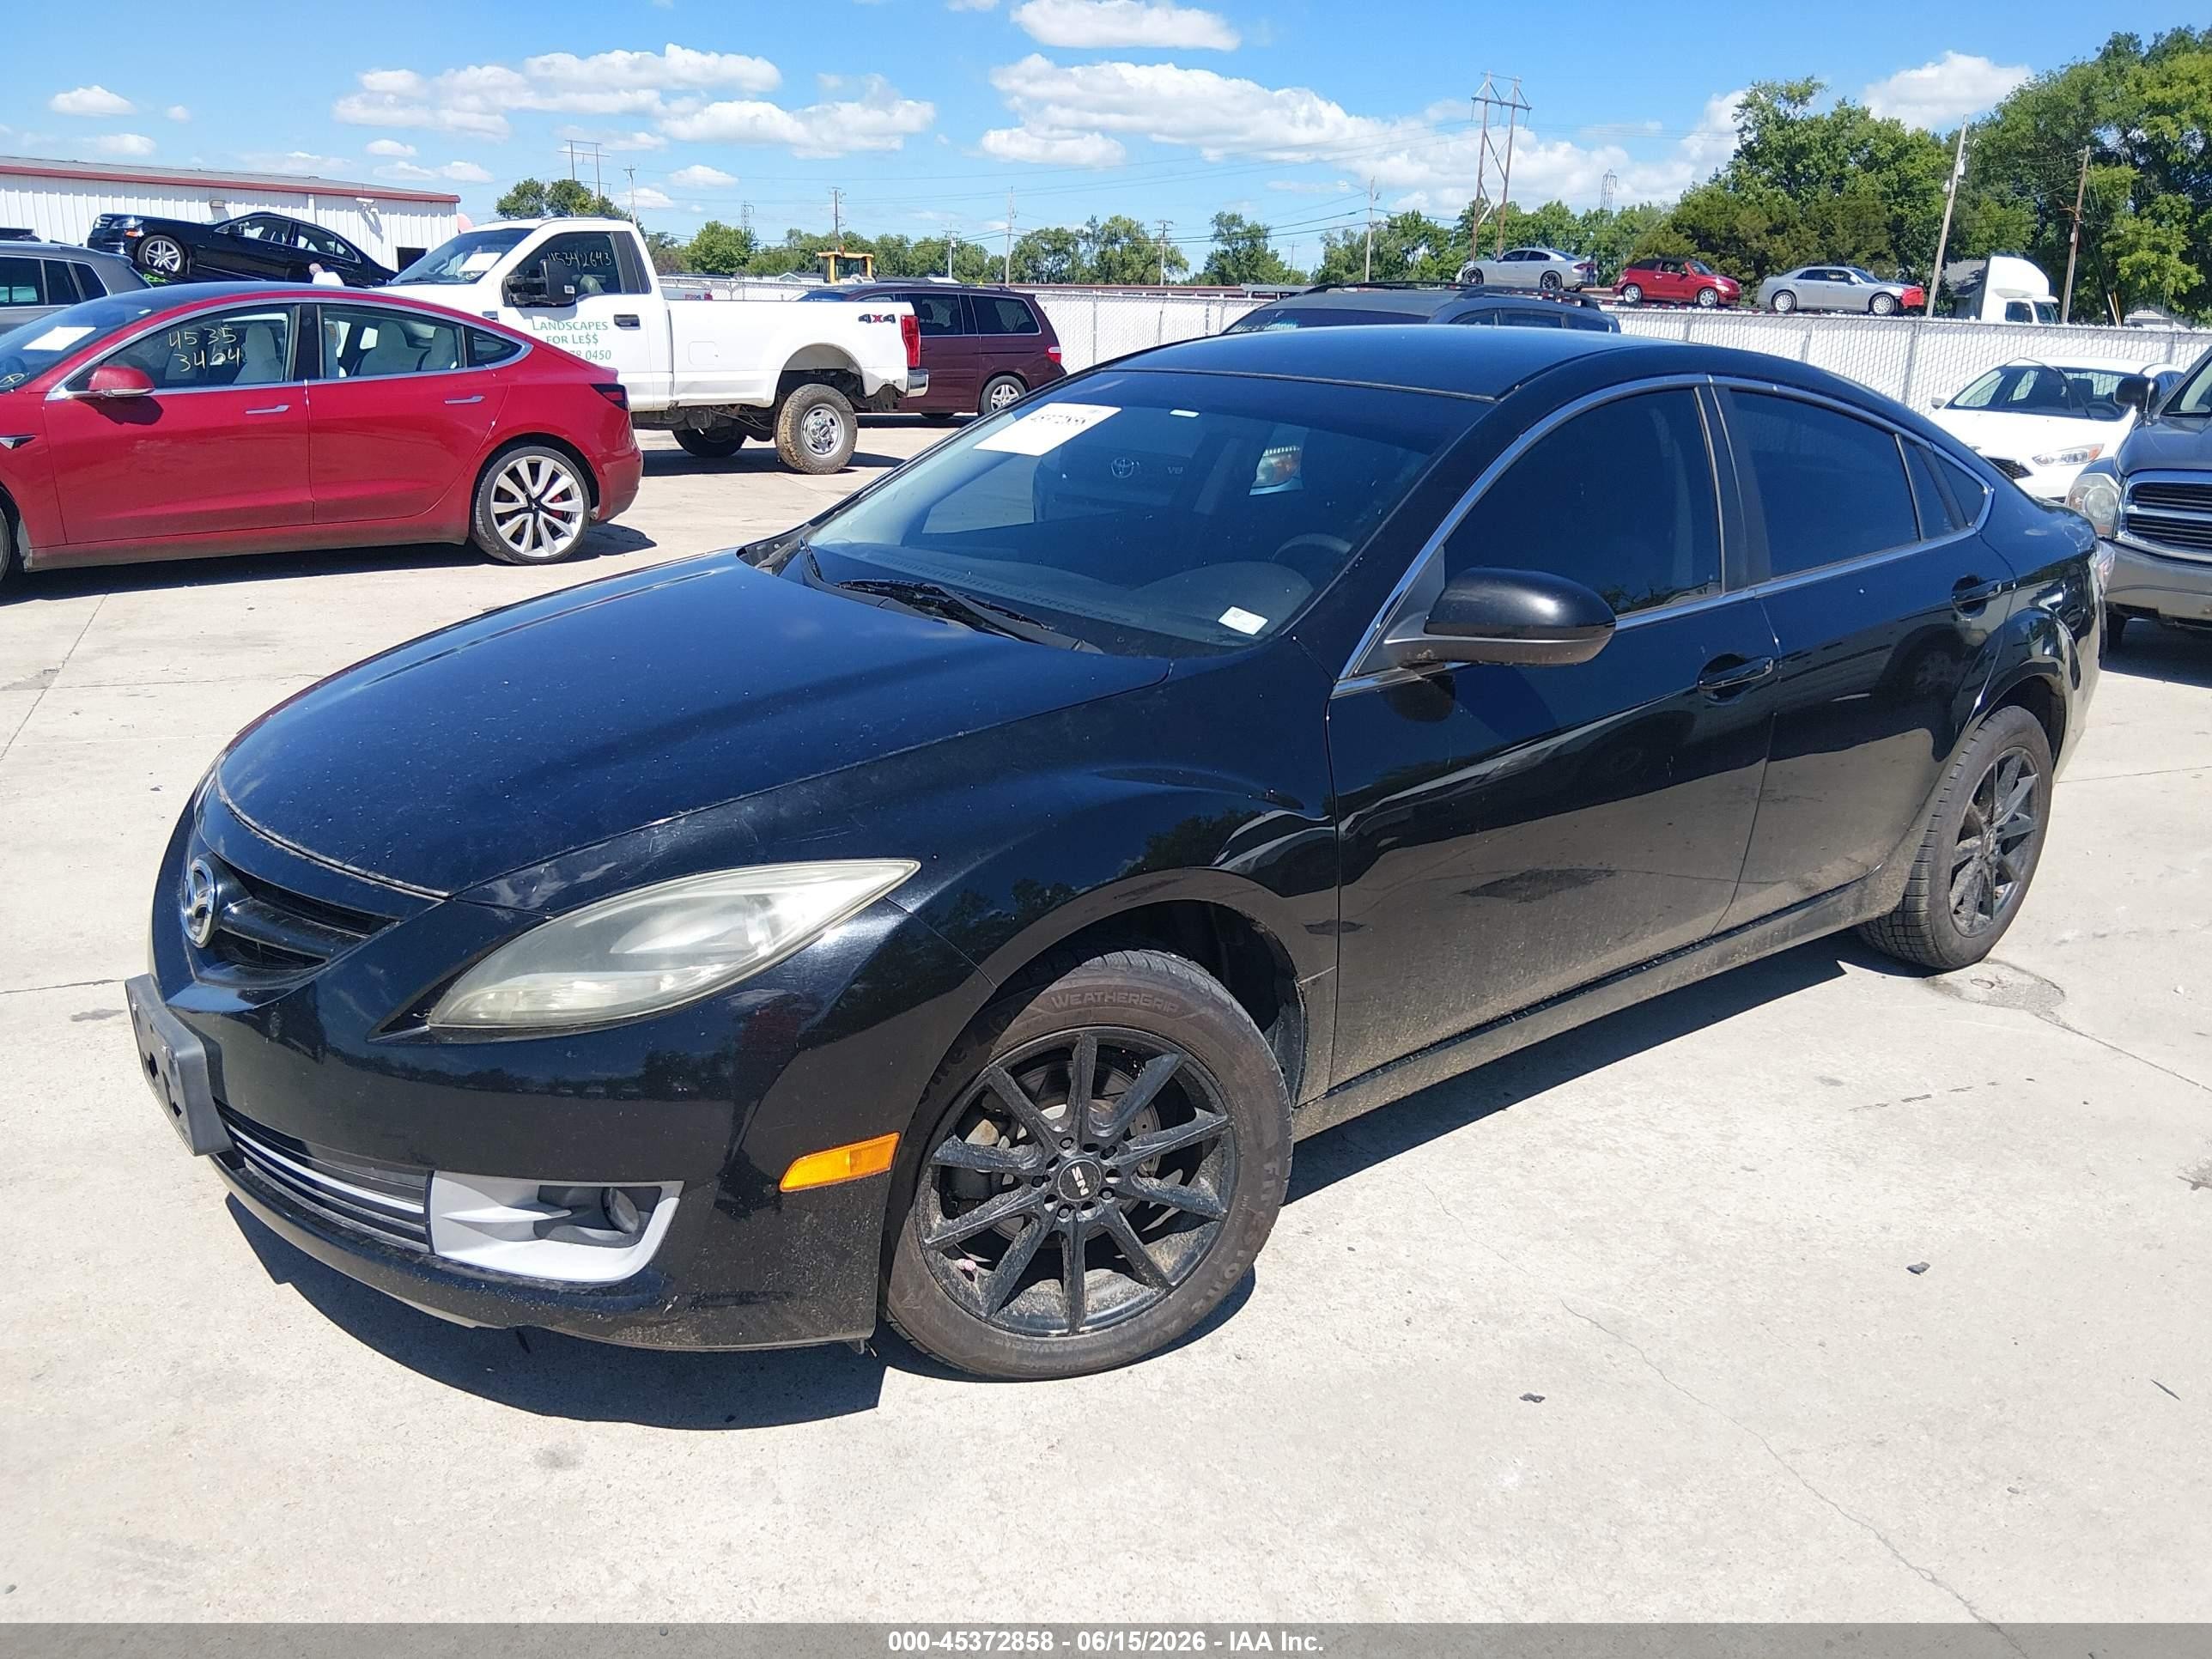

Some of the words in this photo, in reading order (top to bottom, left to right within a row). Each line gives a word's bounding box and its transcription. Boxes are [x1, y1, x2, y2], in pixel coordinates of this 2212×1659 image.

[532, 321, 609, 331] LANDSCAPES
[168, 327, 237, 350] 4535
[546, 335, 568, 343] FOR
[585, 349, 611, 360] 0450
